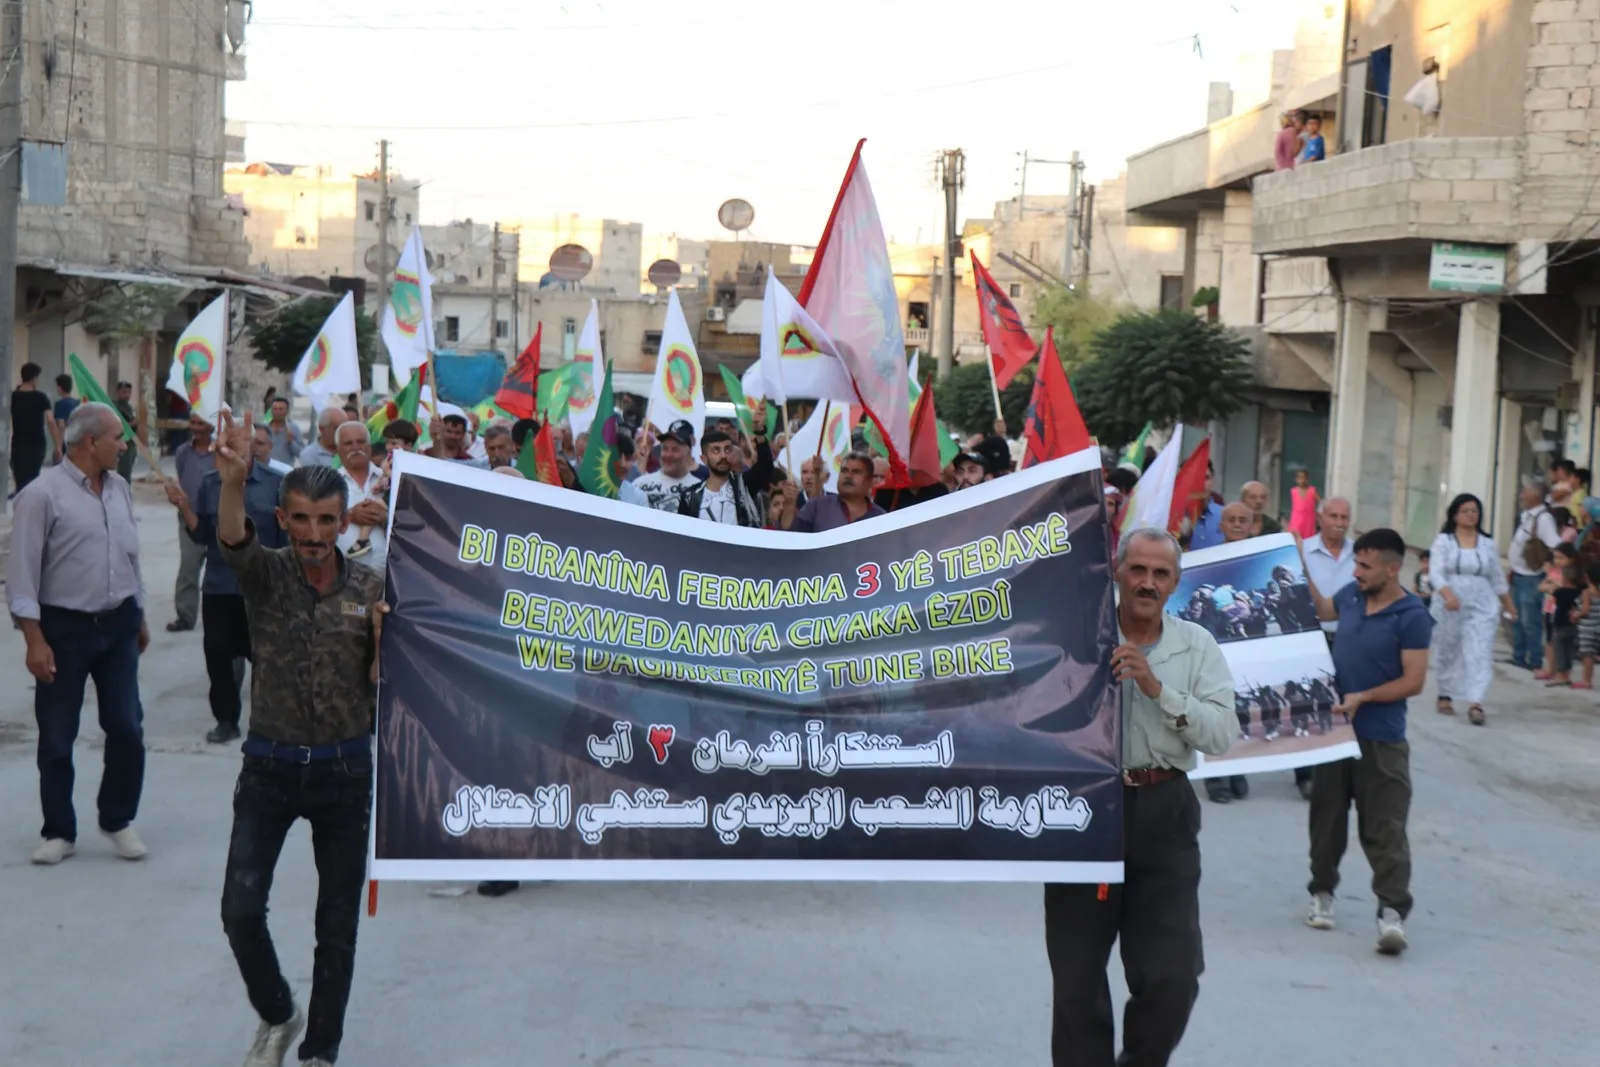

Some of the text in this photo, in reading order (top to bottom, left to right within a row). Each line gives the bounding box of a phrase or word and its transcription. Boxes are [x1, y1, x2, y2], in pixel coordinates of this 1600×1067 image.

[458, 512, 1071, 610] BI BÎRANÎNA FERMANA 3 YÊ TEBAXÊ
[501, 578, 1013, 656] BERXWEDANIYA CIVAKA ÊZDÎ
[516, 635, 576, 672] WE
[825, 650, 923, 689] TUNE
[933, 638, 1013, 678] BIKE
[587, 720, 633, 768] آب
[647, 723, 676, 765] ٣
[692, 730, 802, 775] لفرمان
[443, 784, 1093, 845] مقاومة الشعب الإيزيدي ستنهي الاحتلال
